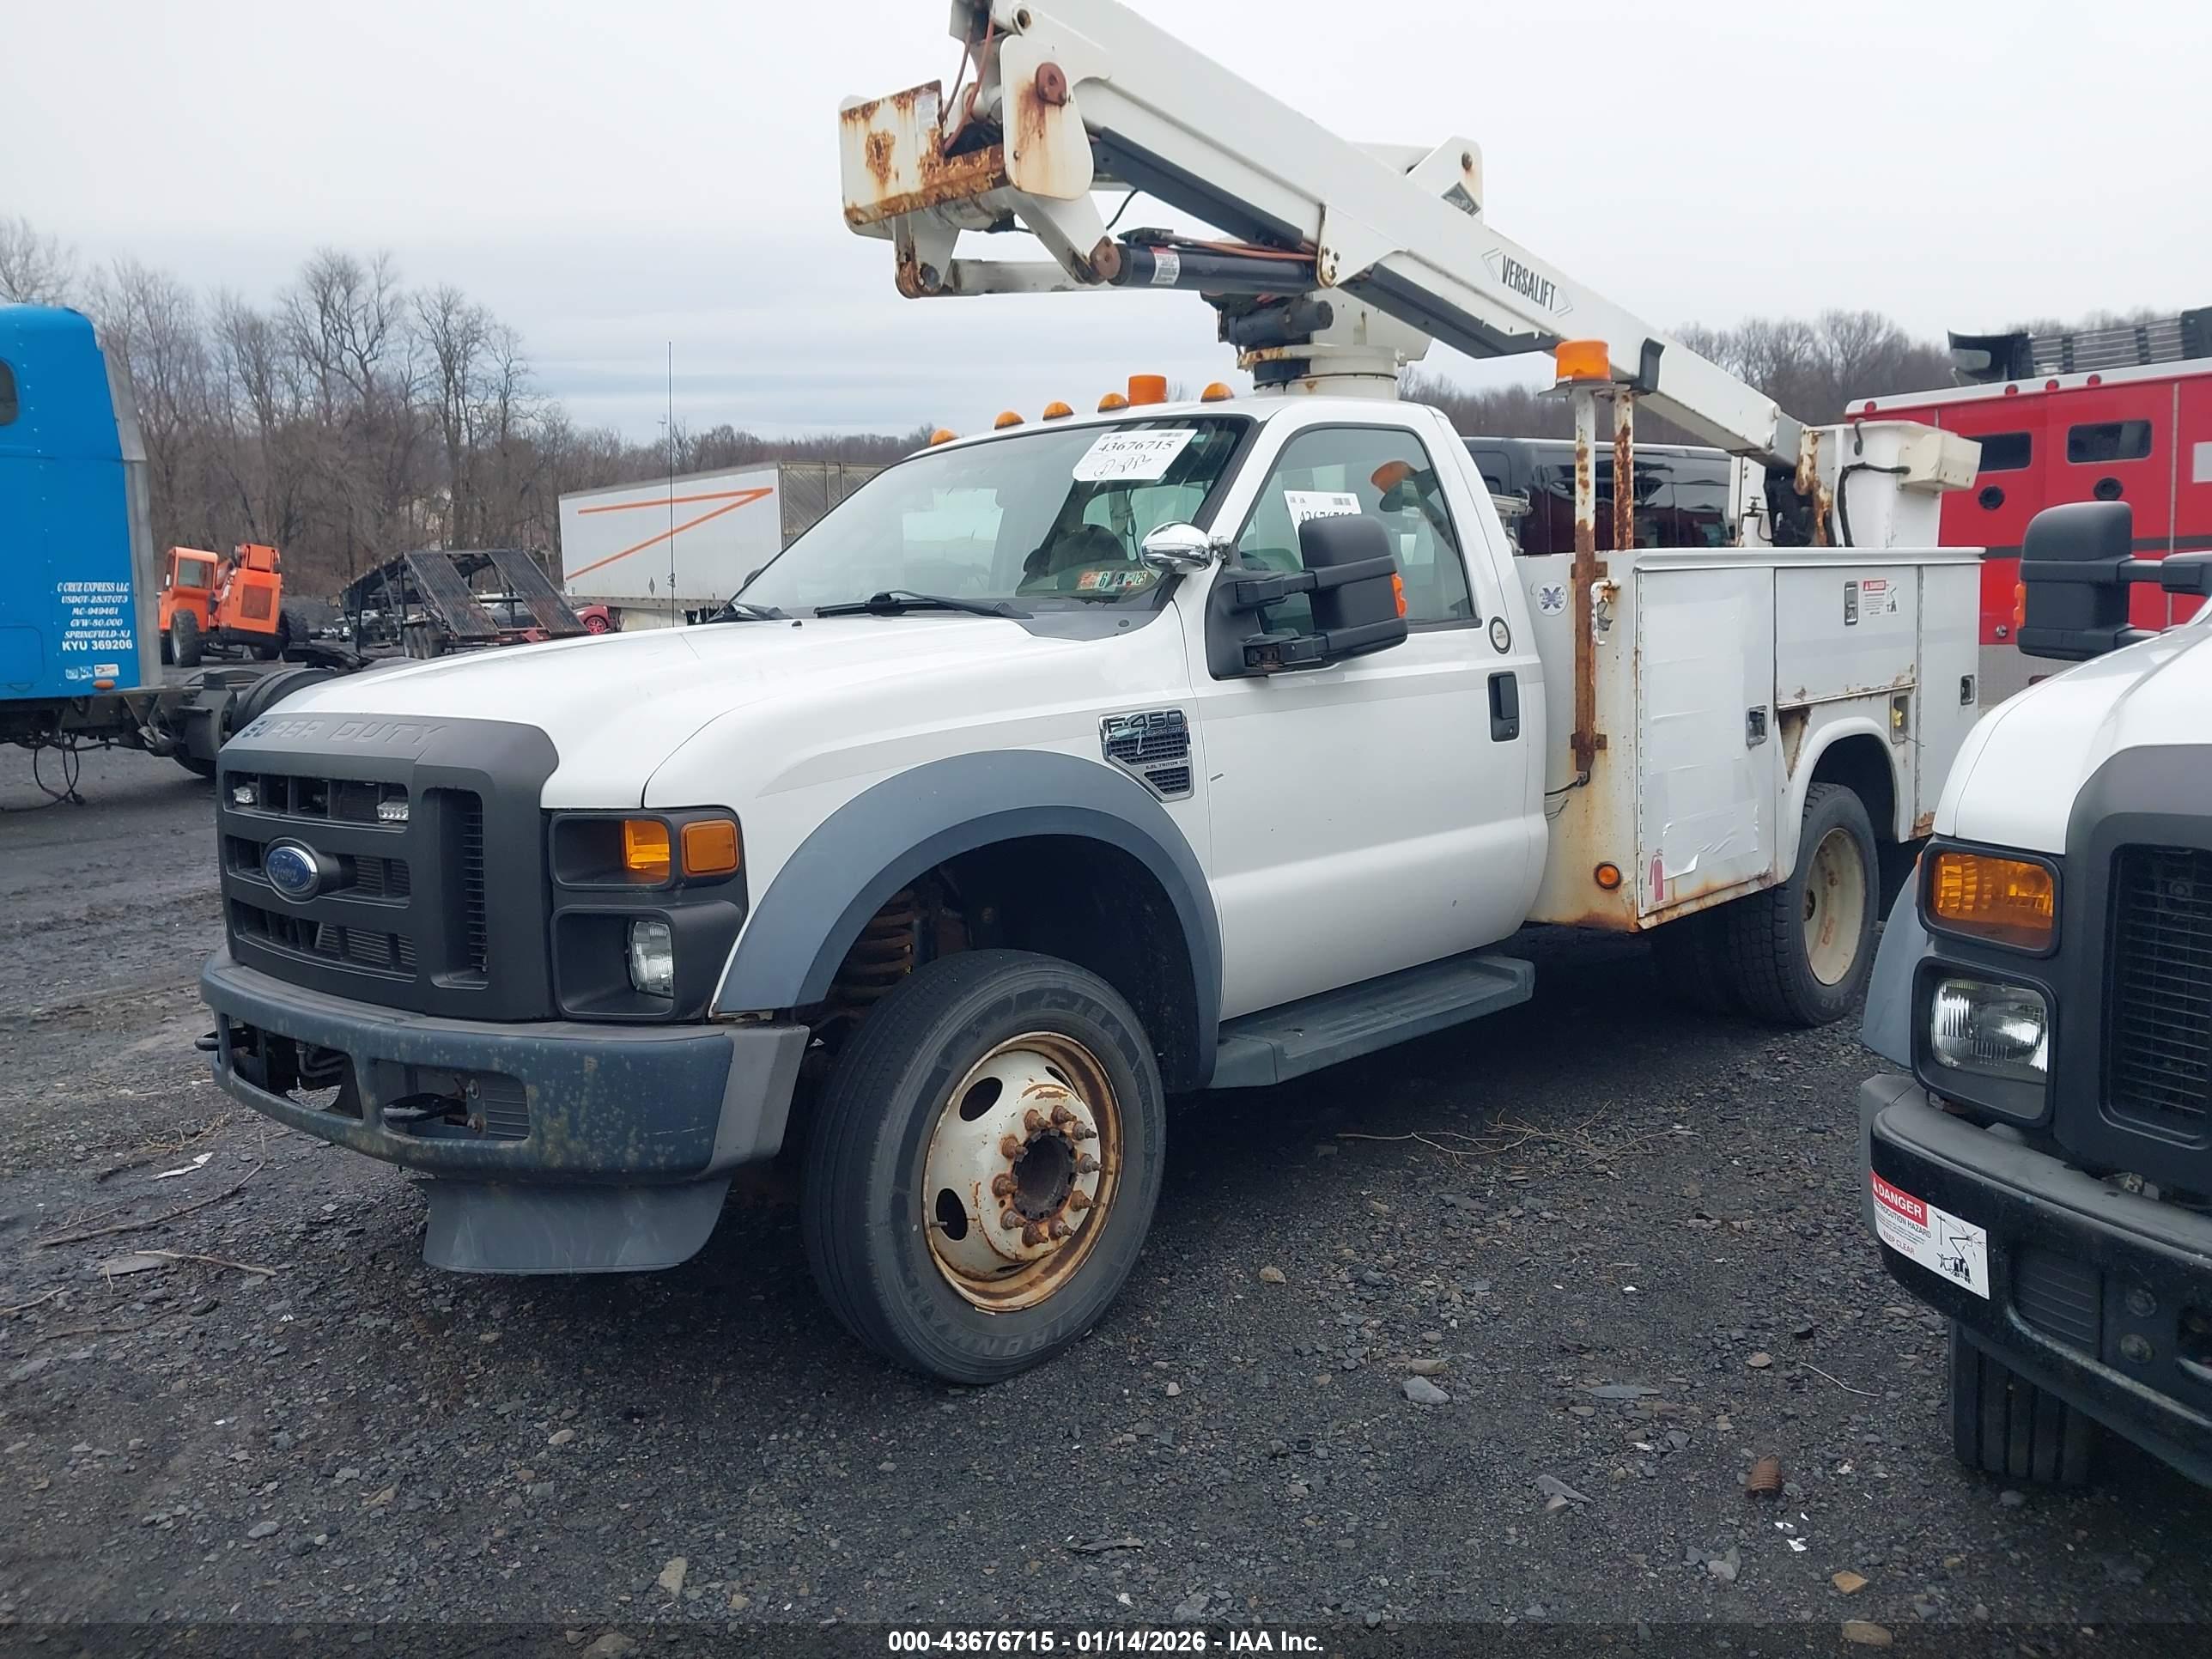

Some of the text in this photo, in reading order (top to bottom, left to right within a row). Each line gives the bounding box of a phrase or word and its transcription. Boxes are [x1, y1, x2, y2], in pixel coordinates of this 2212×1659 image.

[1501, 254, 1556, 311] VERSALIFT
[1099, 441, 1175, 453] 43676715
[83, 582, 115, 592] EXPRESS
[116, 582, 130, 592] LLC
[62, 639, 133, 652] KYU 369206
[242, 720, 447, 746] SUPER DUTY
[1103, 709, 1185, 735] F-450
[1878, 1183, 1923, 1219] DANGER
[1883, 1229, 1915, 1255] KEEP CLEAR
[1907, 1220, 1932, 1238] HAZARD
